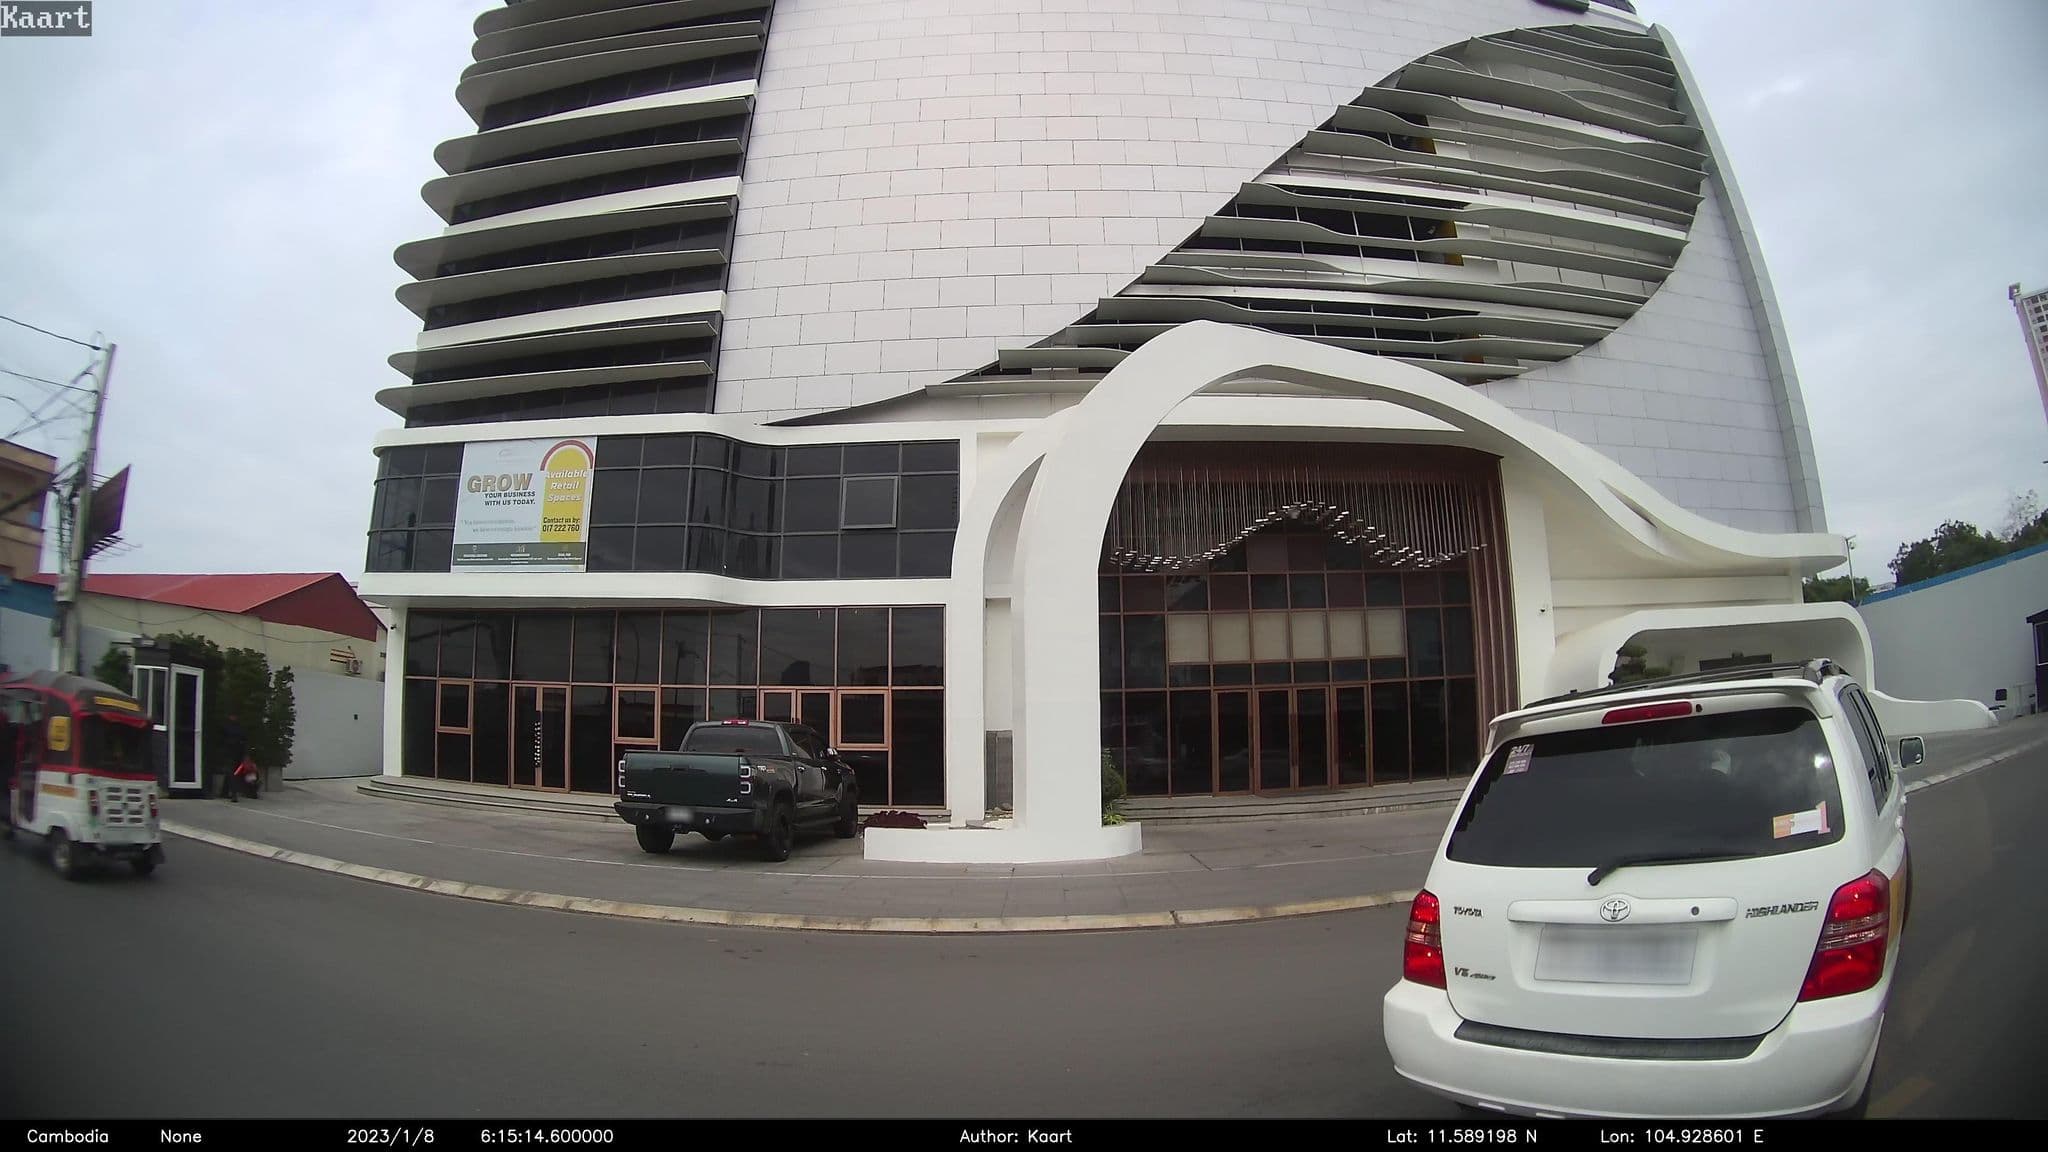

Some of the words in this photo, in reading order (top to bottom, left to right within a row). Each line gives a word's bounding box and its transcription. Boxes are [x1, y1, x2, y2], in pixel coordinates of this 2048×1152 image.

[546, 469, 588, 478] Available
[467, 472, 533, 493] GROW
[551, 481, 580, 489] Retail
[503, 490, 536, 498] BUSINESS
[547, 494, 581, 502] Spaces
[543, 516, 564, 524] Contact
[554, 524, 567, 532] 222
[1453, 906, 1483, 917] TOYOTA
[1745, 901, 1819, 919] HIGHLANDER
